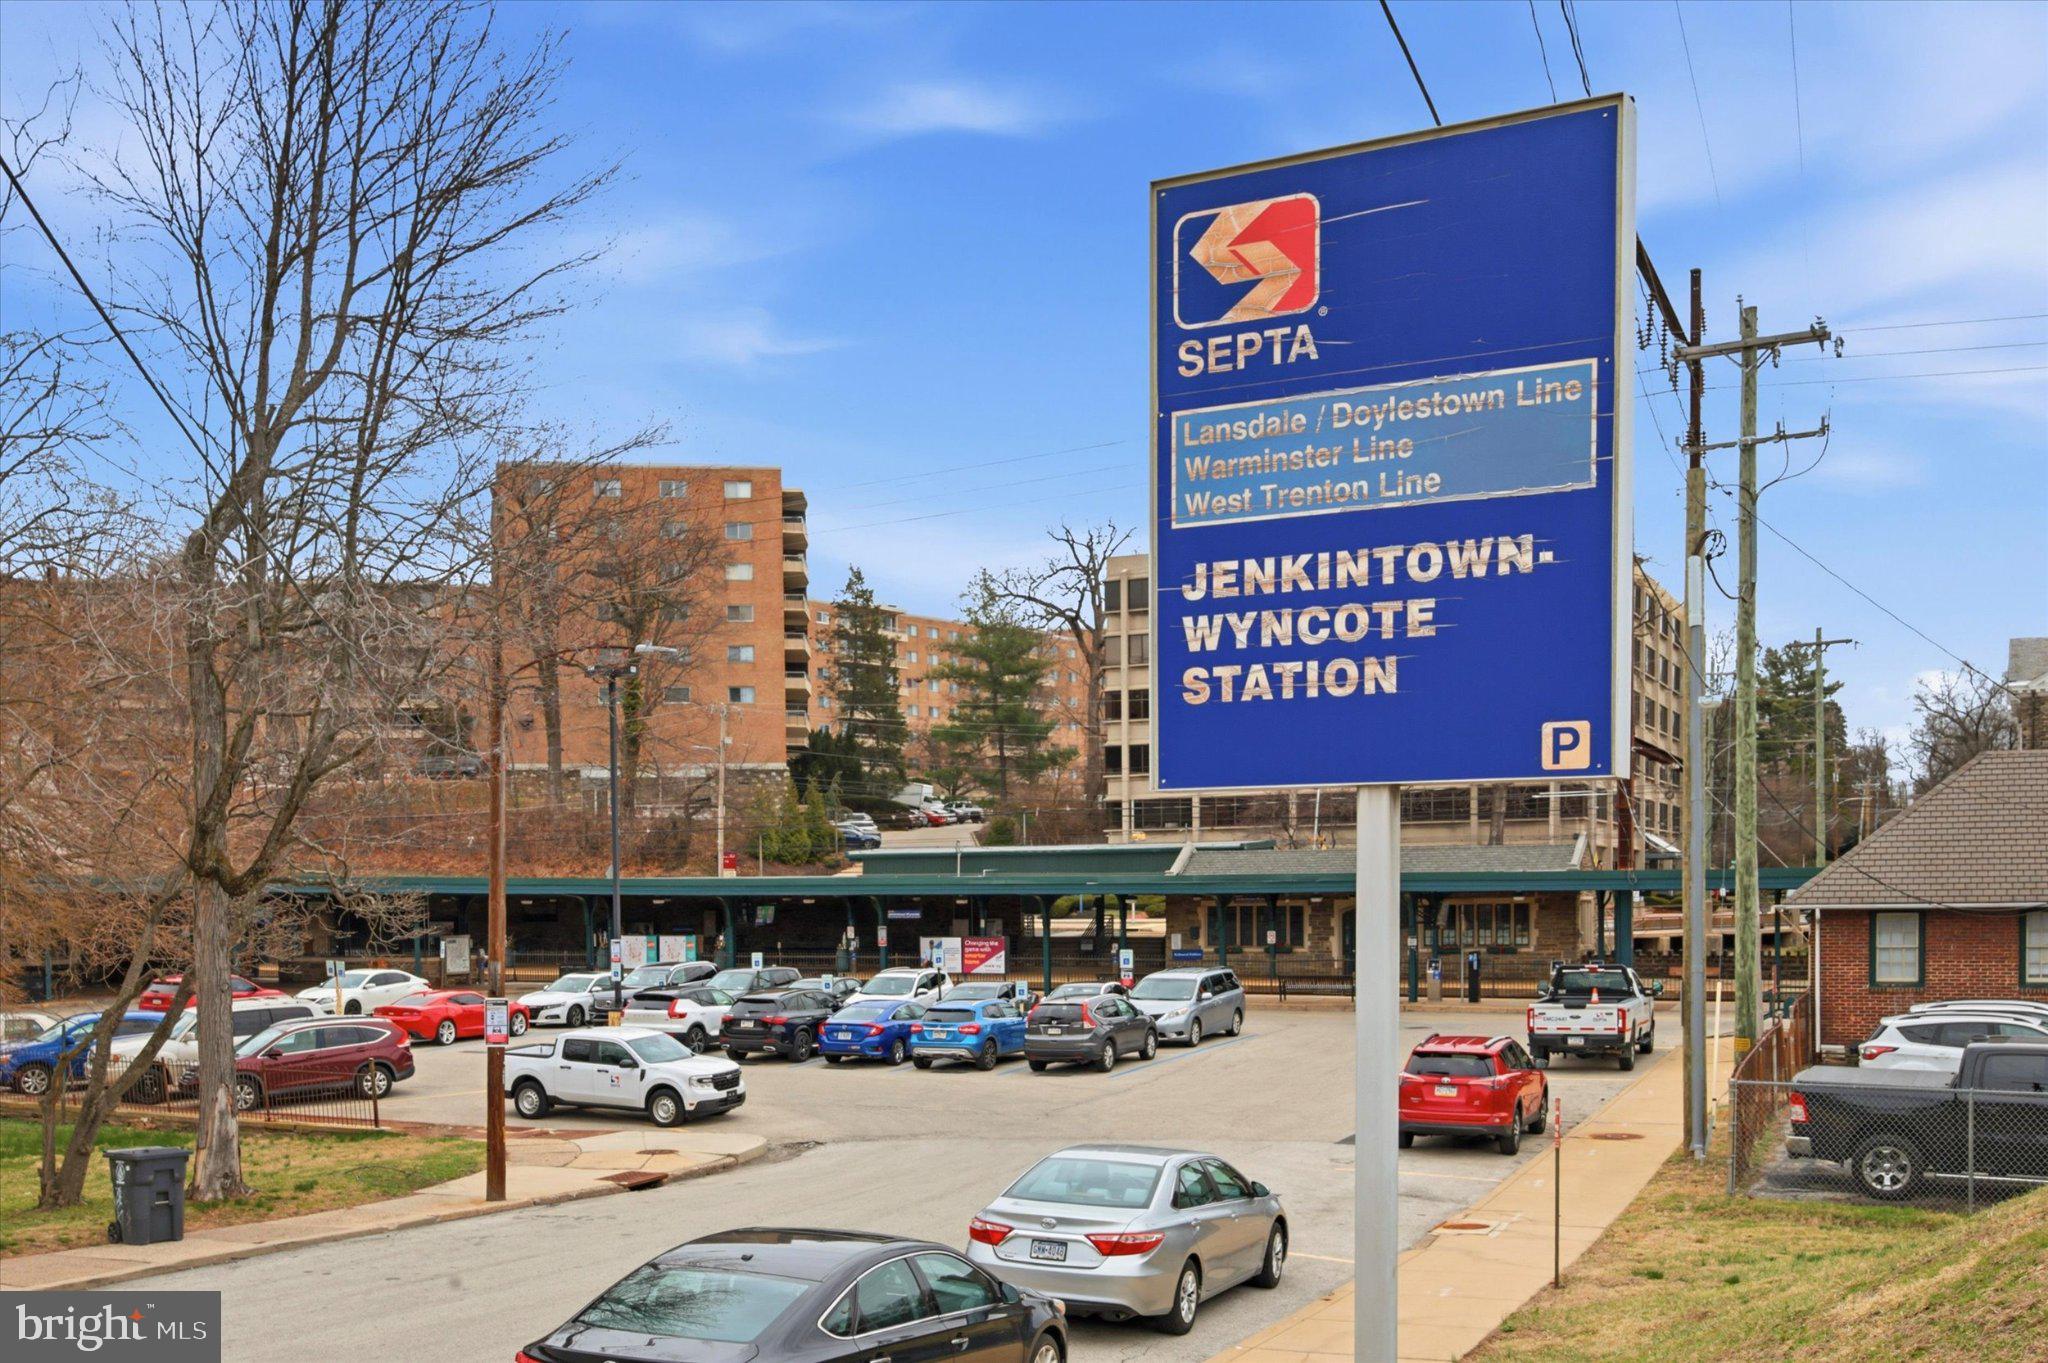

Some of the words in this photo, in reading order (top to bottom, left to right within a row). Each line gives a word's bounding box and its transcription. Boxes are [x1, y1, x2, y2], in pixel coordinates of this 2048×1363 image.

[1178, 325, 1319, 377] SEPTA
[1184, 408, 1307, 447] Lansdale
[1333, 386, 1506, 431] Doylestown
[1517, 377, 1582, 407] Line
[1185, 440, 1343, 481] Warminster
[1353, 435, 1413, 464] Line
[1185, 487, 1263, 517] West
[1260, 478, 1369, 508] Trenton
[1379, 469, 1441, 497] Line
[1182, 598, 1437, 652] WYNCOTE
[1182, 655, 1398, 705] STATION
[1552, 727, 1581, 765] P
